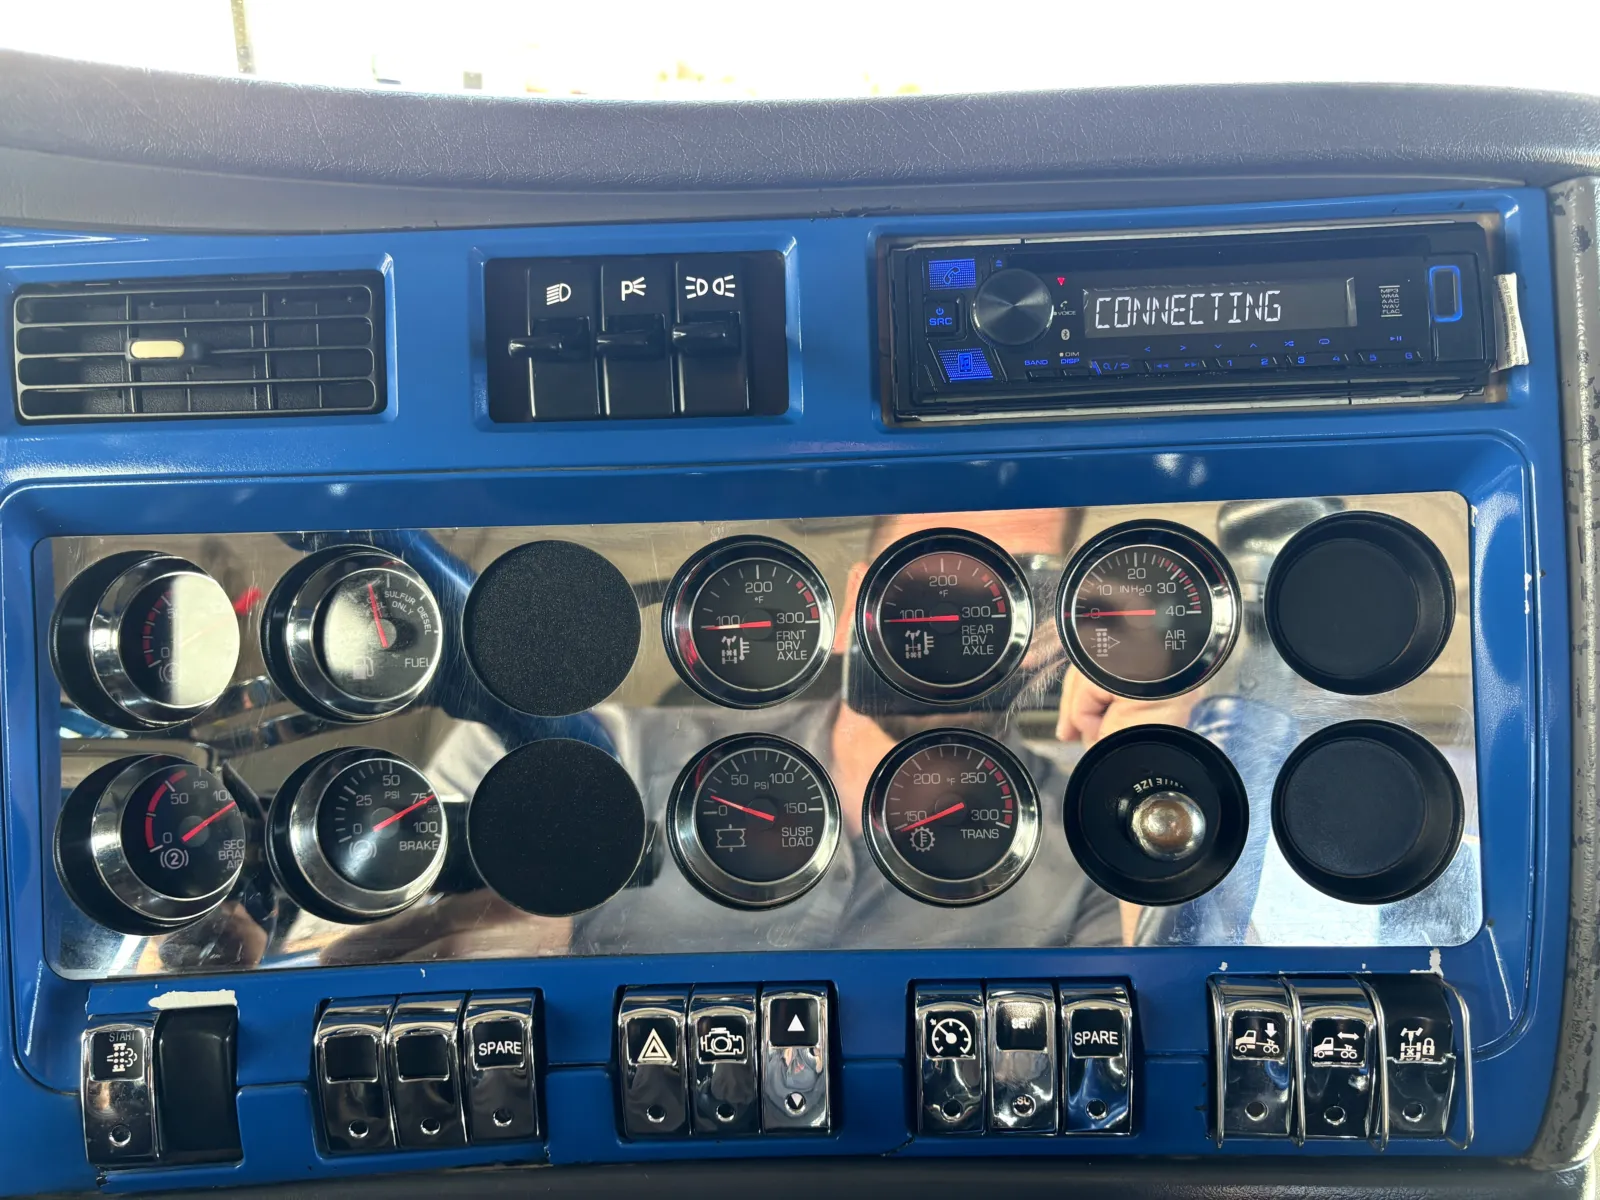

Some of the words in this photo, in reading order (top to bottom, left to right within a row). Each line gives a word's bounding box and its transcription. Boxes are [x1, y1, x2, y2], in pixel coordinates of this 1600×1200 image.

[1095, 290, 1281, 329] CONNECTING
[929, 317, 953, 326] SRC
[1261, 358, 1269, 366] 2
[1297, 356, 1306, 364] 3
[1127, 568, 1147, 580] 20
[929, 574, 958, 587] 200
[744, 581, 773, 593] 200
[1098, 584, 1113, 596] 10
[1156, 582, 1177, 594] 30
[939, 589, 949, 598] °F
[754, 596, 764, 604] °F
[384, 590, 416, 605] SULFUR
[417, 605, 432, 636] DIESEL
[391, 600, 414, 616] ONLY
[961, 606, 991, 618] 300
[1165, 605, 1186, 617] 40
[716, 615, 741, 626] 100
[776, 612, 805, 624] 300
[900, 609, 924, 620] 100
[776, 630, 806, 640] FRNT
[962, 625, 994, 635] REAR
[1165, 630, 1186, 640] AIR
[776, 640, 801, 650] DRV
[962, 635, 987, 645] DRV
[1164, 640, 1188, 651] FILT
[776, 651, 807, 661] AXLE
[962, 645, 994, 655] AXLE
[404, 657, 431, 668] FUEL
[382, 774, 401, 787] 50
[730, 774, 749, 786] 50
[769, 772, 795, 784] 100
[913, 773, 941, 785] 200
[960, 772, 987, 784] 250
[193, 780, 209, 789] PSI
[754, 781, 770, 790] PSI
[170, 792, 189, 805] 50
[355, 794, 373, 807] 25
[384, 790, 400, 799] PSI
[410, 792, 429, 804] 75
[718, 804, 728, 817] 0
[784, 802, 808, 814] 150
[904, 810, 927, 822] 150
[971, 809, 999, 821] 300
[353, 823, 363, 834] 0
[412, 821, 439, 833] 100
[781, 826, 813, 837] SUSP
[163, 832, 173, 844] 0
[960, 828, 999, 839] TRANS
[223, 838, 245, 850] SEC
[399, 840, 439, 851] BRAKE
[781, 837, 814, 848] LOAD
[1074, 1030, 1119, 1046] SPARE
[478, 1040, 522, 1056] SPARE
